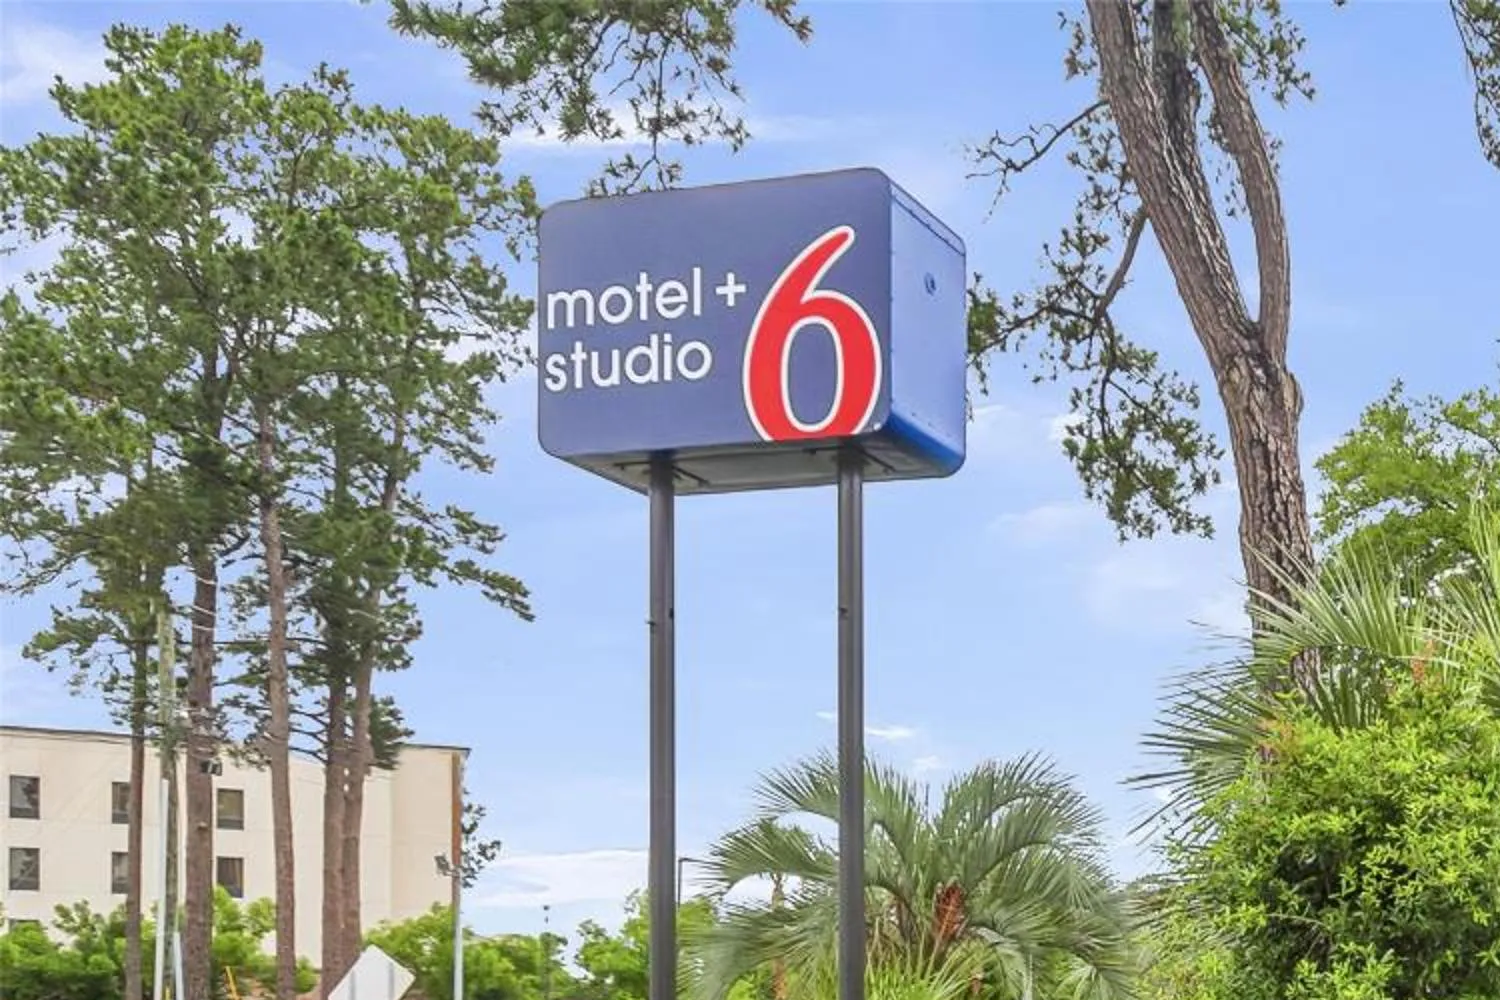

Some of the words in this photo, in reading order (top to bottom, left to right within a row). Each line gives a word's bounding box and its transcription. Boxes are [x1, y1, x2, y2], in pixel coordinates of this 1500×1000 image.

[547, 267, 702, 329] motel
[544, 333, 713, 392] studio
[743, 225, 882, 442] 6
